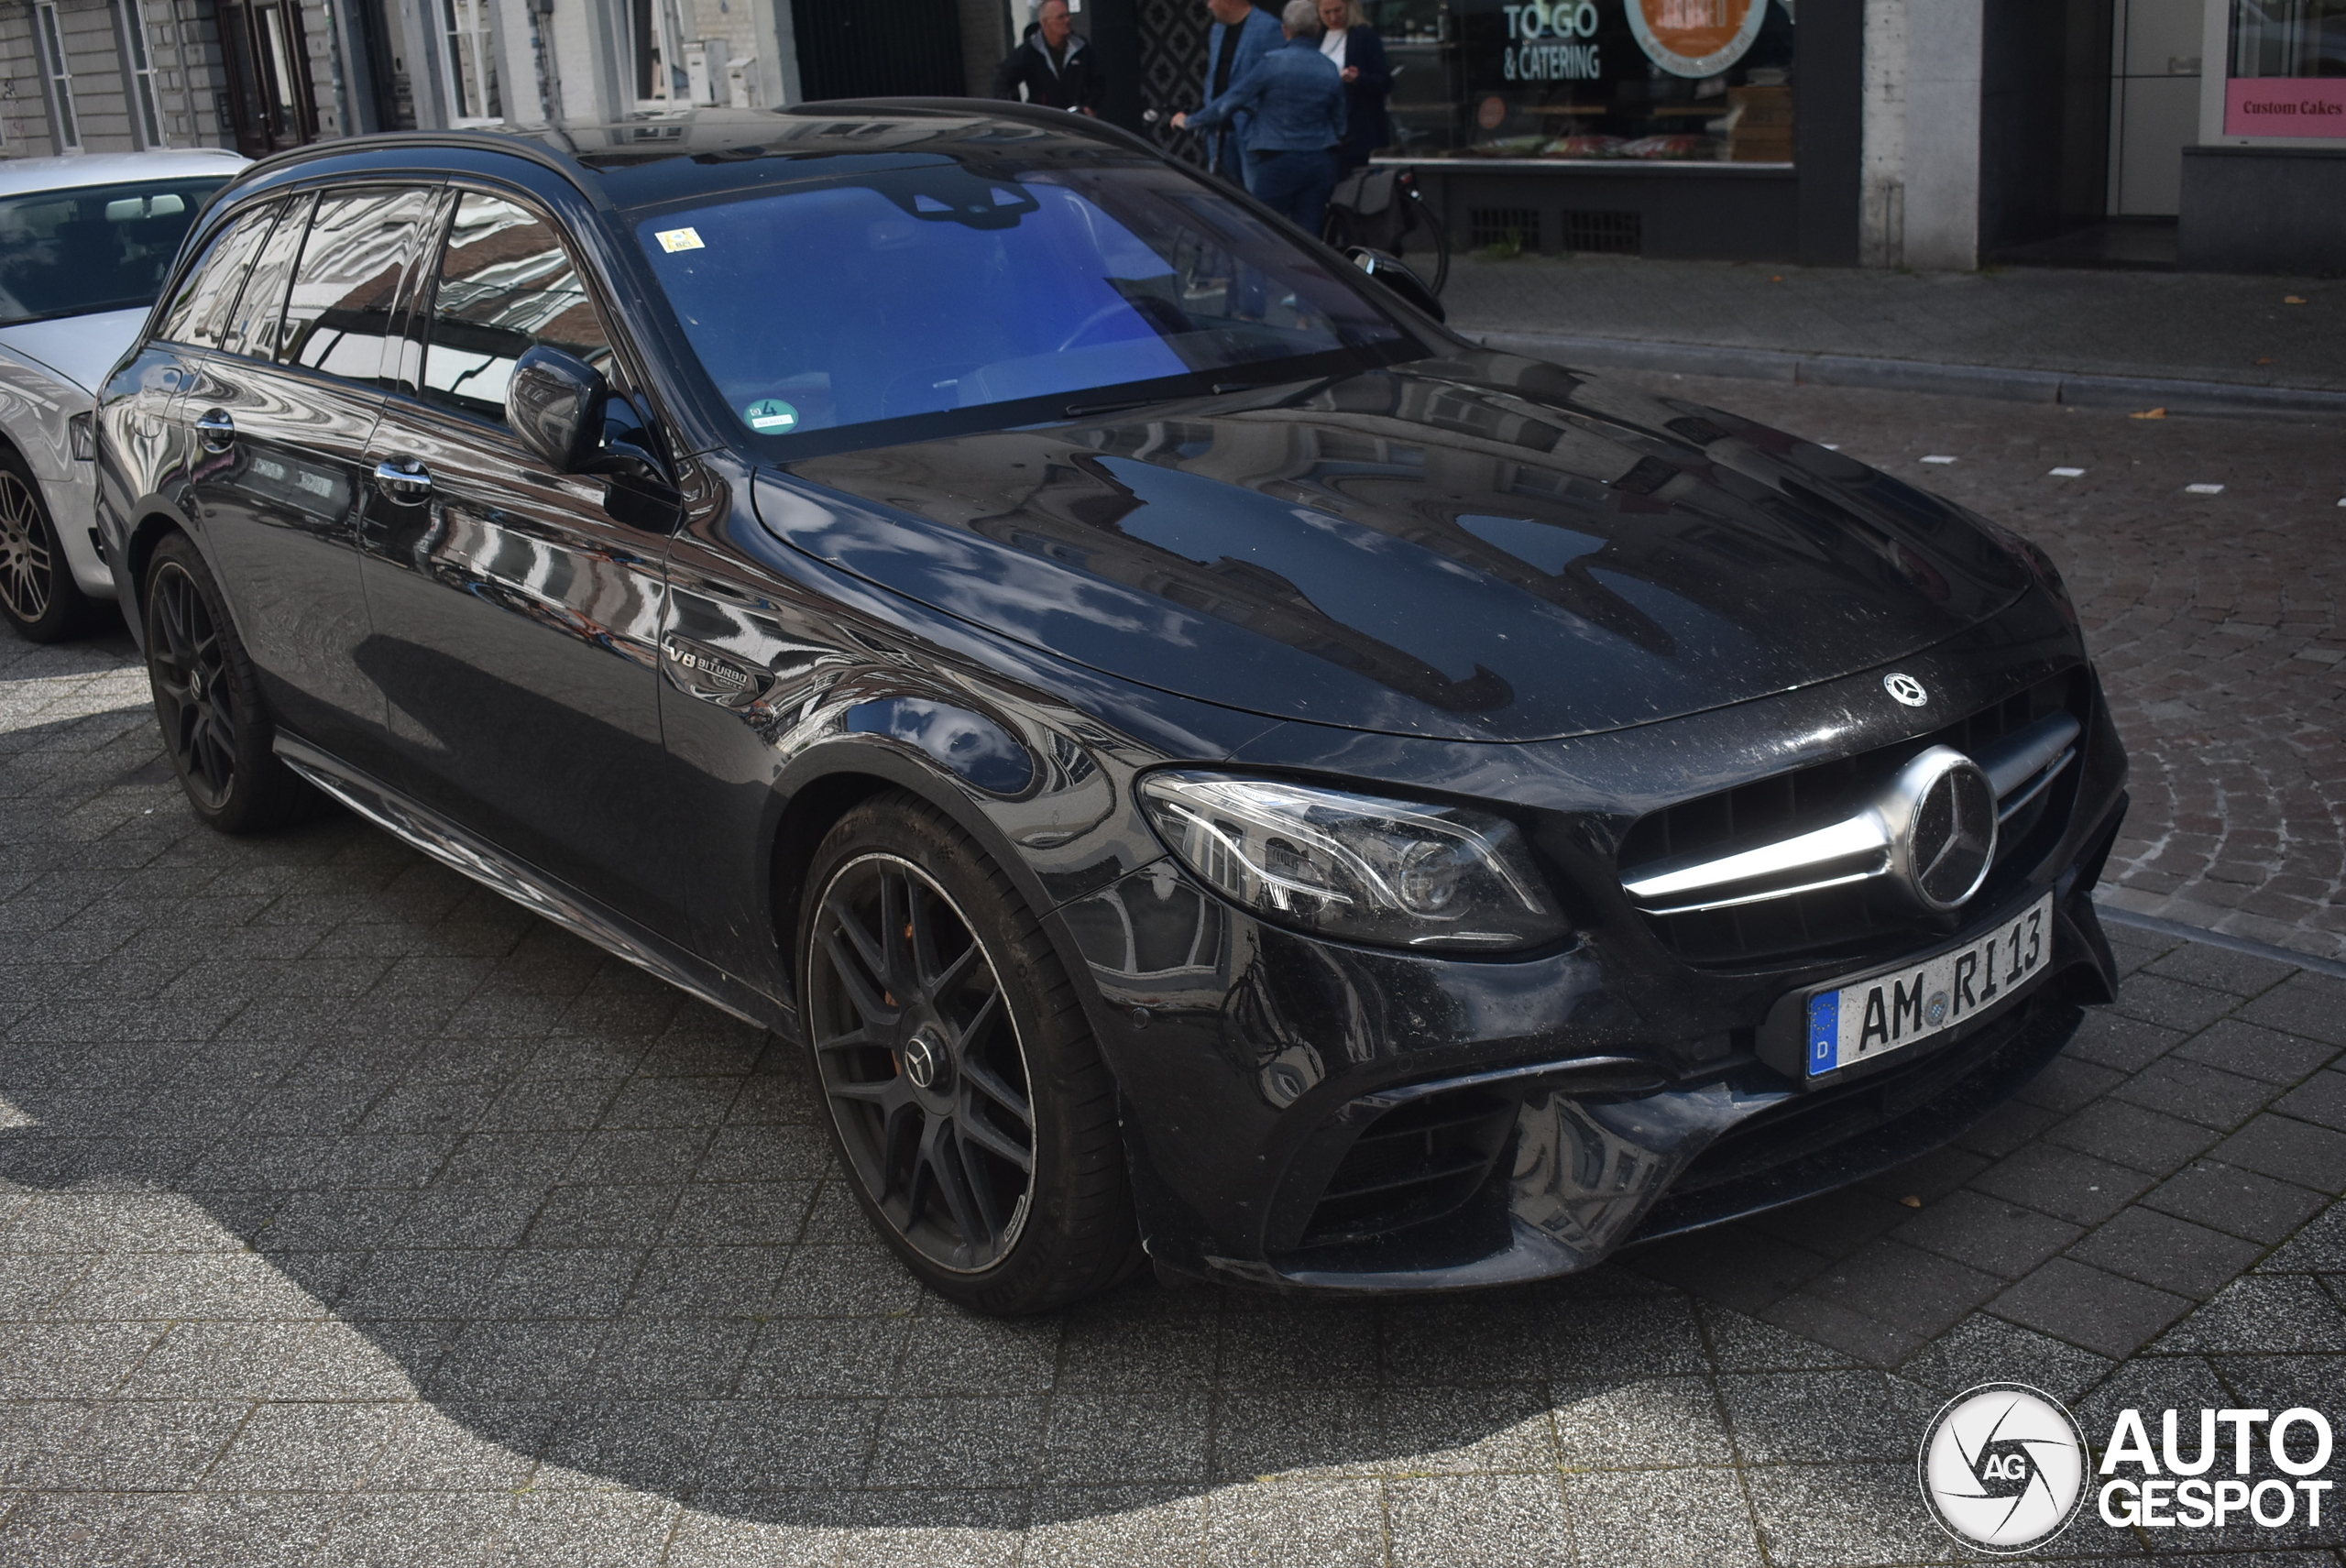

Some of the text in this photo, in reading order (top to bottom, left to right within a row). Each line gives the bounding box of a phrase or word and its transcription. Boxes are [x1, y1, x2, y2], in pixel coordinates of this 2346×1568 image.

[1503, 2, 1598, 39] TO GO
[1504, 46, 1517, 81] &
[1518, 43, 1601, 81] CATERING
[2243, 99, 2343, 115] Custom Cakes
[762, 400, 777, 416] 4
[669, 645, 748, 684] V8 BITURBO
[1858, 907, 2042, 1051] AM RI 13
[1816, 1041, 1828, 1059] D
